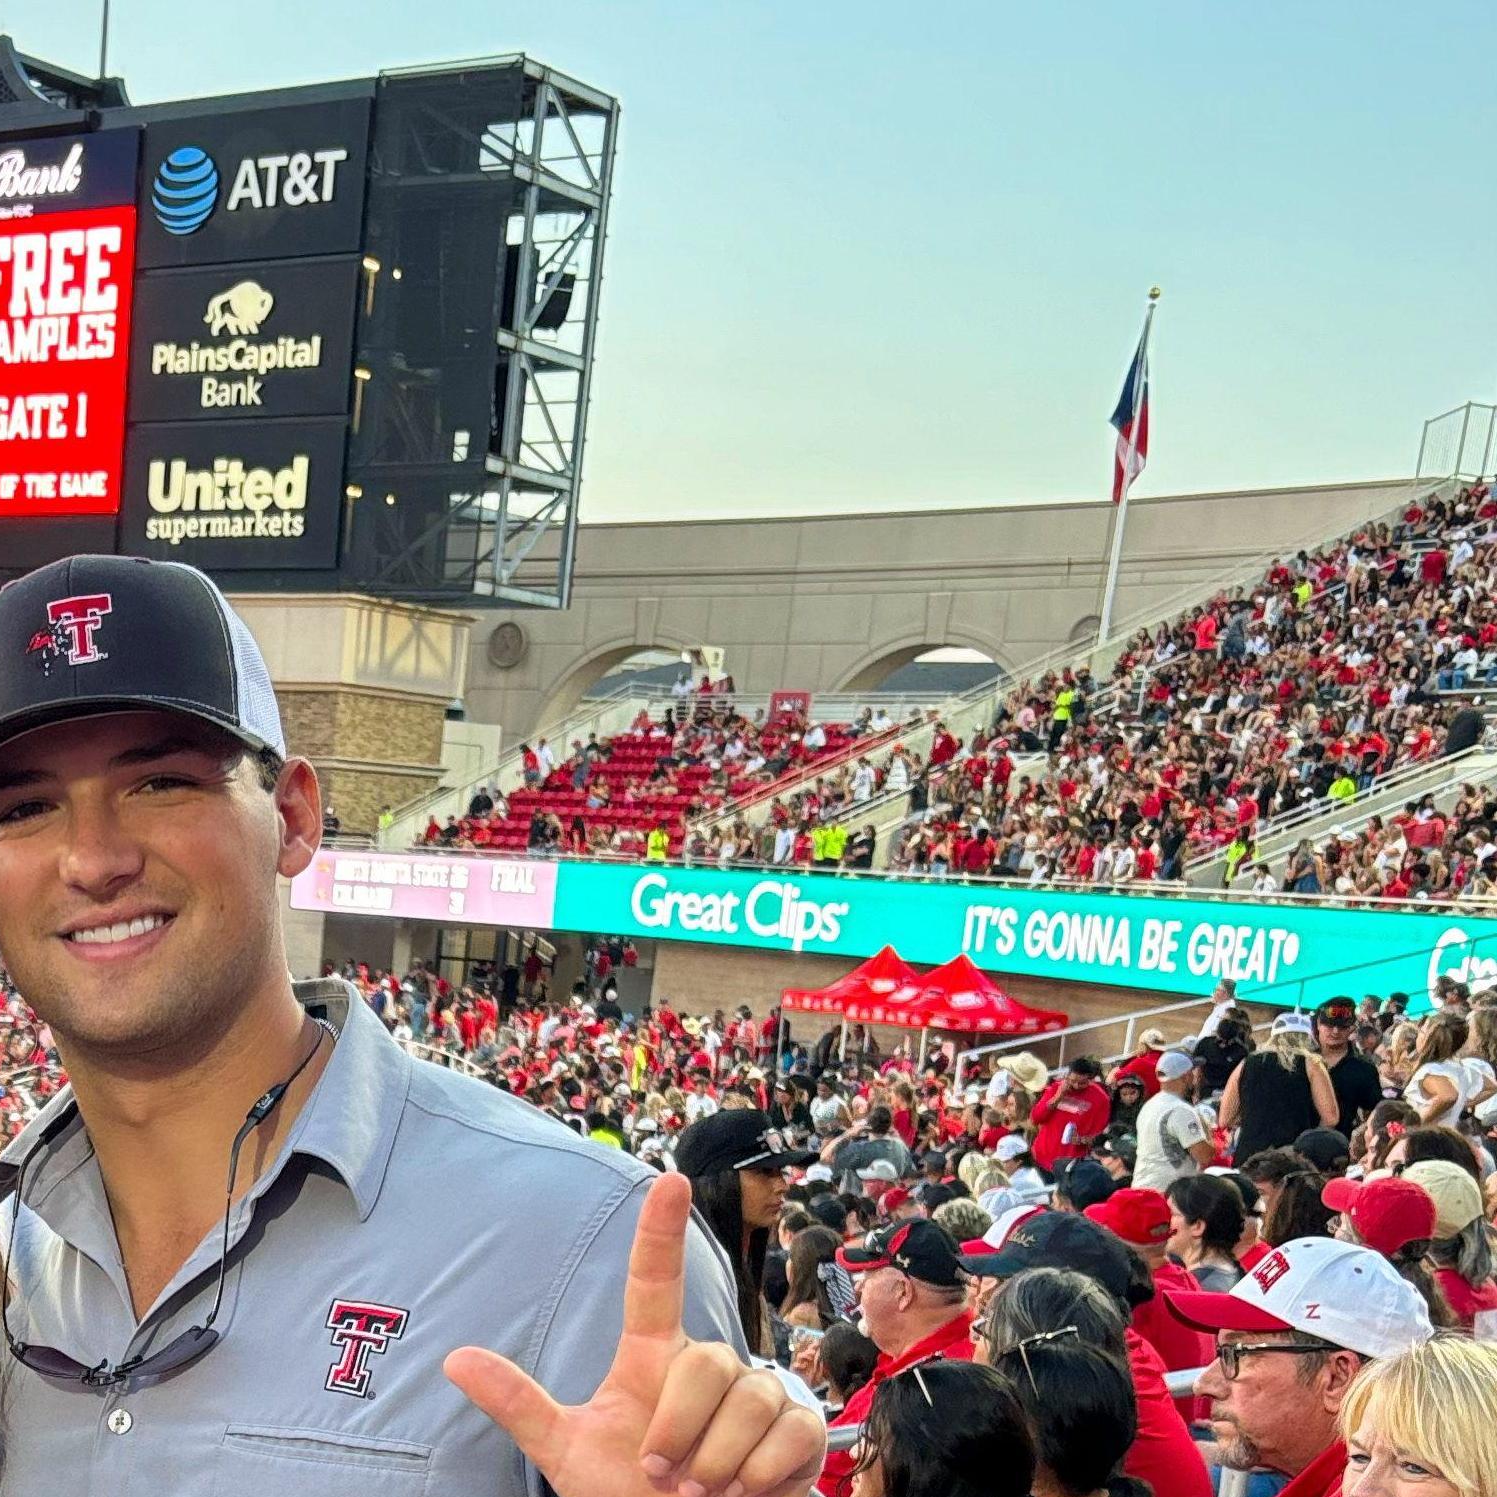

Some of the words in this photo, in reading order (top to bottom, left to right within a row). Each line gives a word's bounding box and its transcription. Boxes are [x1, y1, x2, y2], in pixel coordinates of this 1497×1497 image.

[227, 149, 347, 212] AT&T
[152, 335, 322, 376] PlainsCapital
[201, 375, 263, 408] Bank
[75, 393, 87, 437] 1
[24, 474, 57, 497] THE
[60, 473, 108, 497] GAME
[148, 455, 310, 513] United
[146, 509, 305, 545] supermarkets
[631, 874, 740, 934] Great
[744, 881, 841, 952] Clips
[961, 905, 1017, 953] IT'S
[1023, 911, 1131, 967] GONNA
[1138, 919, 1182, 973] BE
